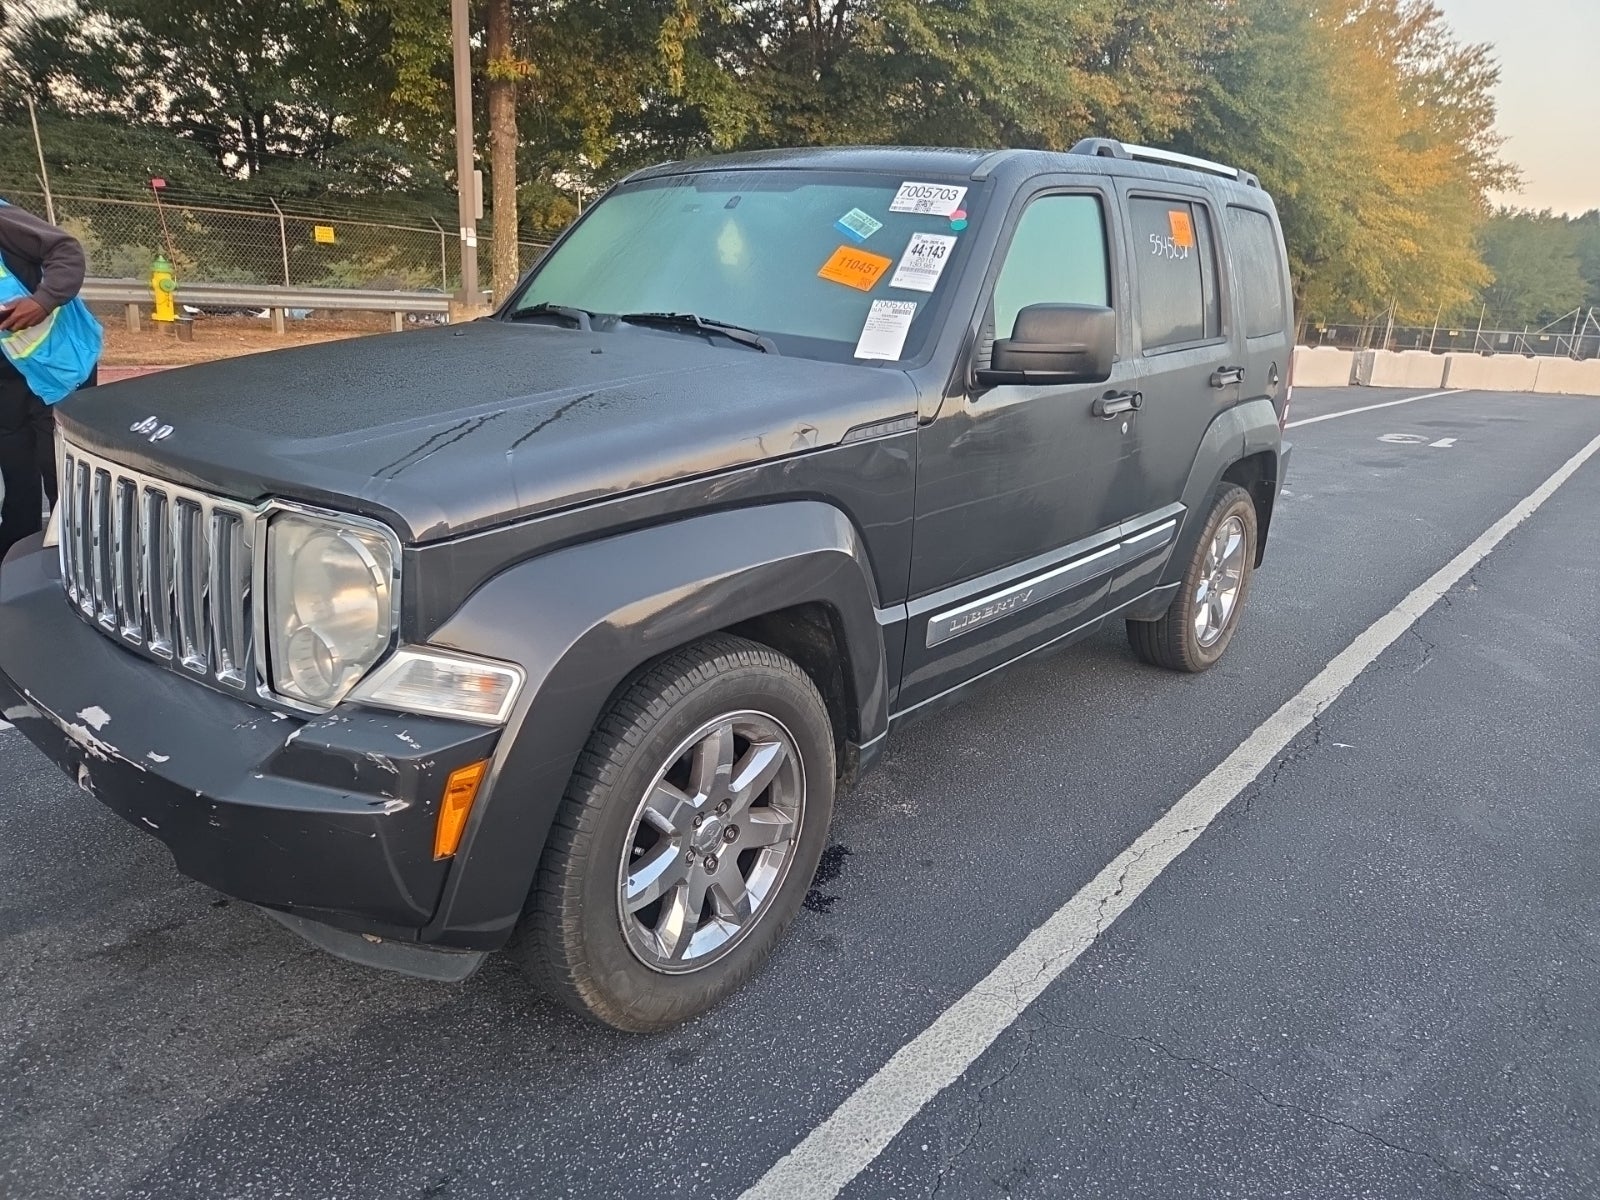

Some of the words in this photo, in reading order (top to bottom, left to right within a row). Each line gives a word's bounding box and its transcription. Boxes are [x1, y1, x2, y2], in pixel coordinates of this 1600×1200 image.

[900, 185, 959, 201] 7005703
[911, 243, 947, 259] 44:143
[839, 256, 880, 276] 110451
[875, 300, 916, 310] 7005703
[949, 588, 1034, 632] LIBERTY
